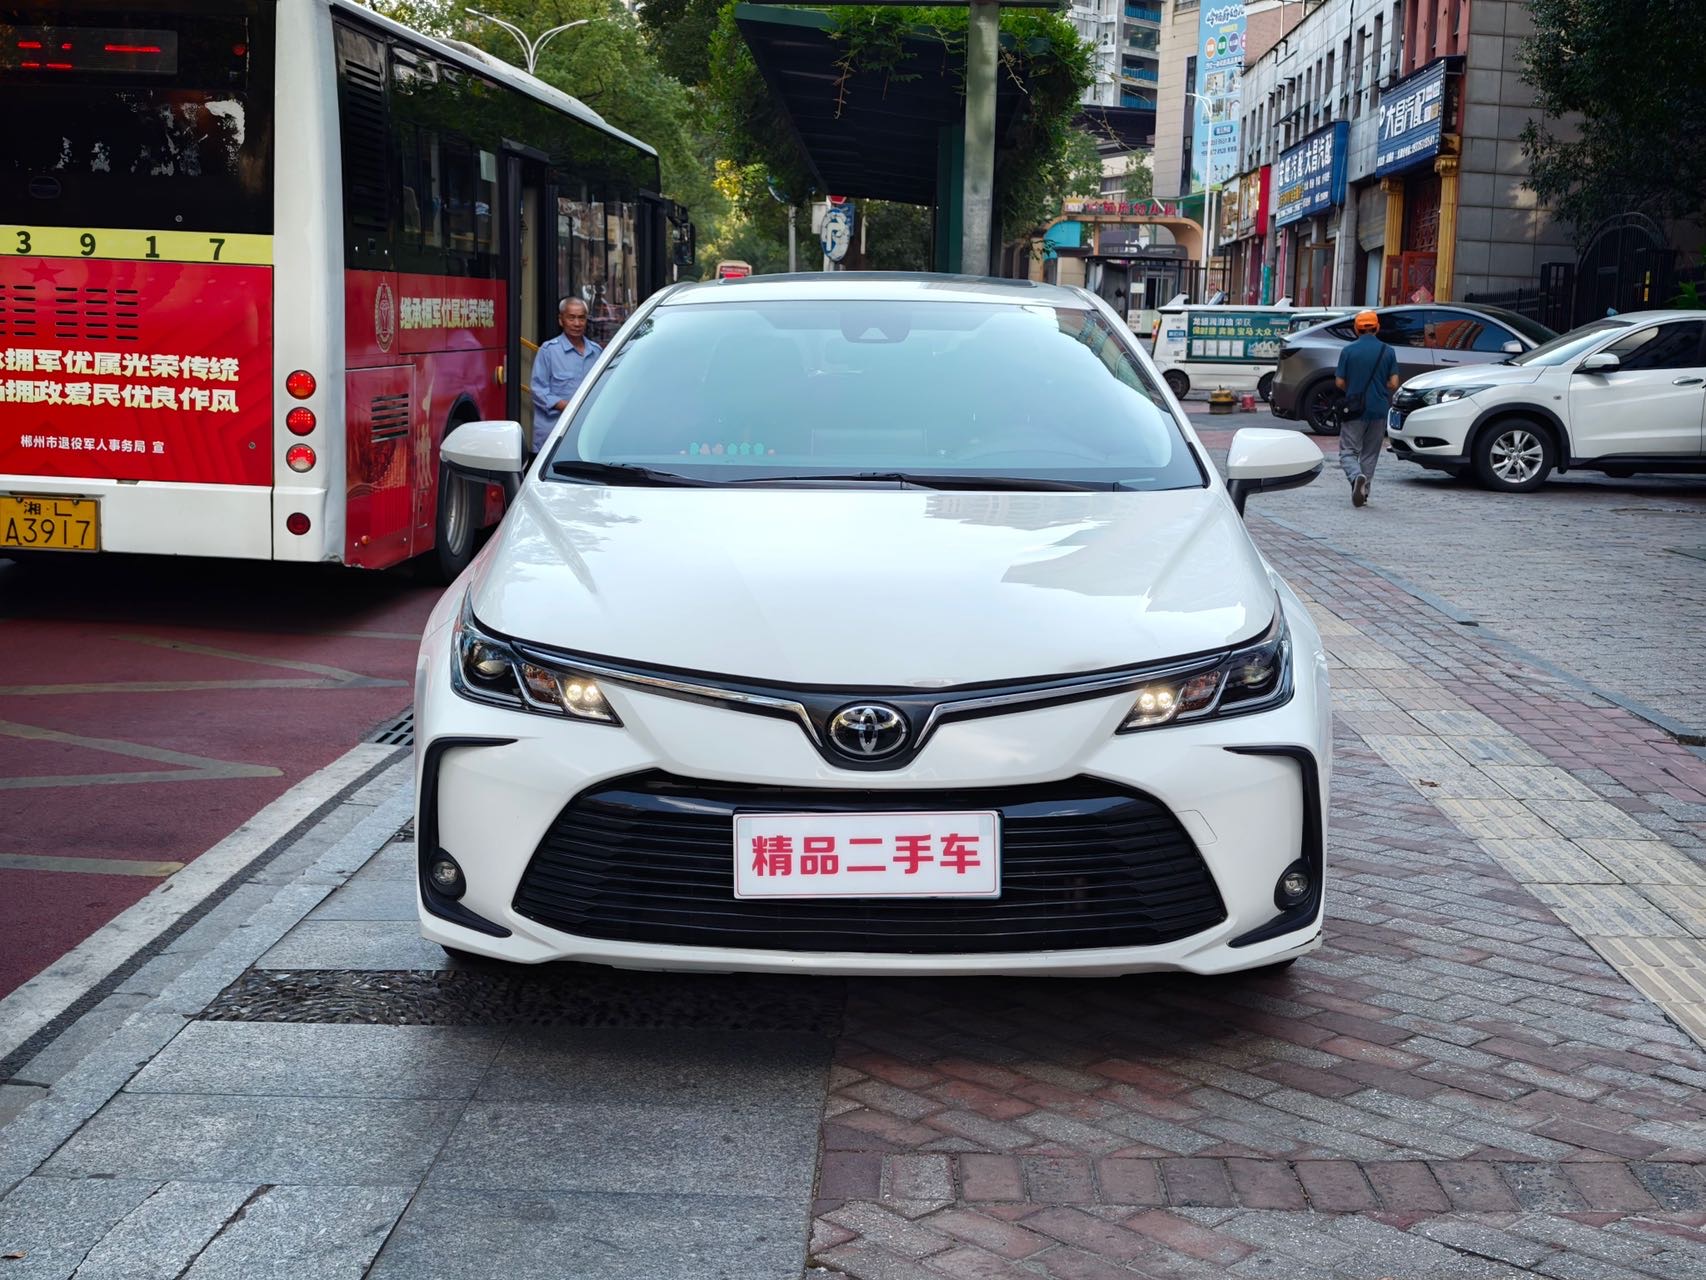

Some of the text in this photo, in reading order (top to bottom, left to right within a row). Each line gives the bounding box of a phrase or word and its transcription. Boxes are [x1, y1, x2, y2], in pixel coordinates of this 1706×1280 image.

[1384, 88, 1426, 140] 大昌汽配
[1304, 132, 1333, 175] 大昌汽配
[399, 296, 495, 329] 继承拥军优属光荣传统
[1237, 326, 1254, 337] 宝马
[1255, 327, 1272, 337] 大众
[0, 348, 239, 382] 拥军优属光荣传统
[0, 379, 239, 413] 拥政爱民优良作风
[21, 434, 165, 454] 郴州市退役军人事务局 宣
[5, 517, 91, 546] A3917
[751, 833, 981, 877] 精品二手车
